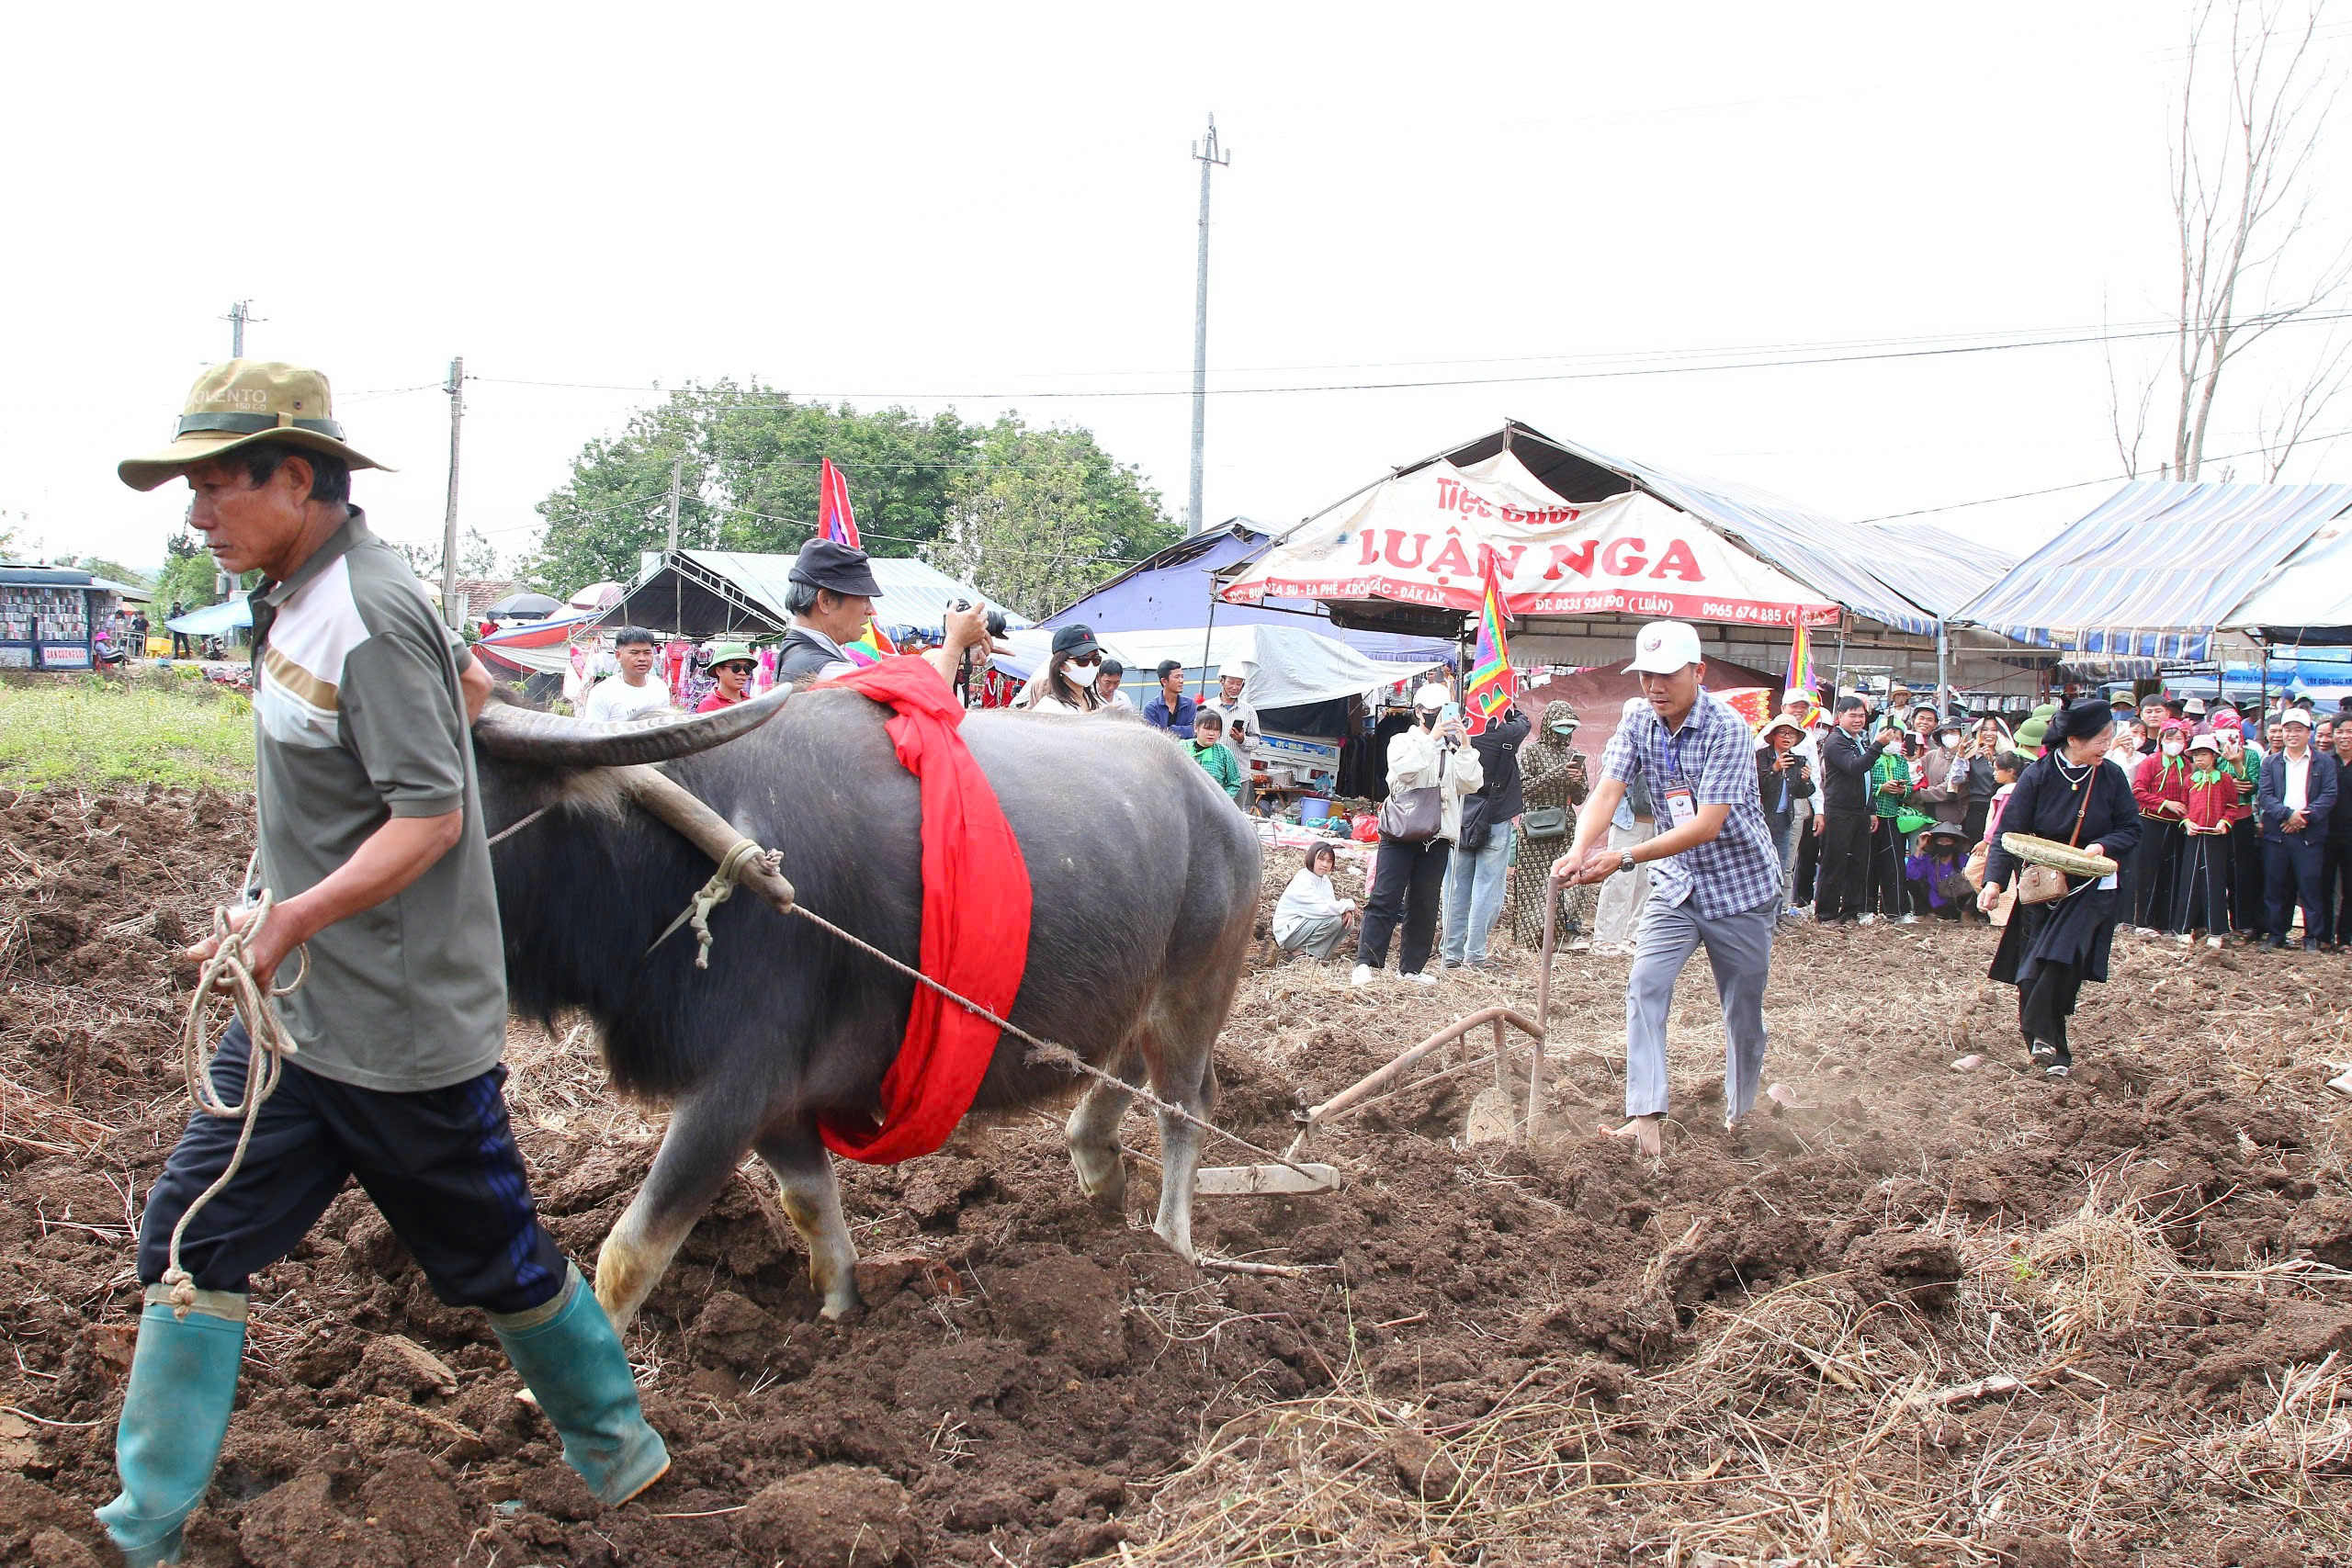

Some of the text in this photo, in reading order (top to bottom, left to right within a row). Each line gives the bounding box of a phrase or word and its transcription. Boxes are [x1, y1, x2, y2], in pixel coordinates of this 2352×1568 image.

[1544, 536, 1706, 582] NGA
[1555, 597, 1581, 610] 0333
[1702, 602, 1733, 618] 0965
[1735, 605, 1758, 620] 674
[1760, 608, 1781, 623] 885
